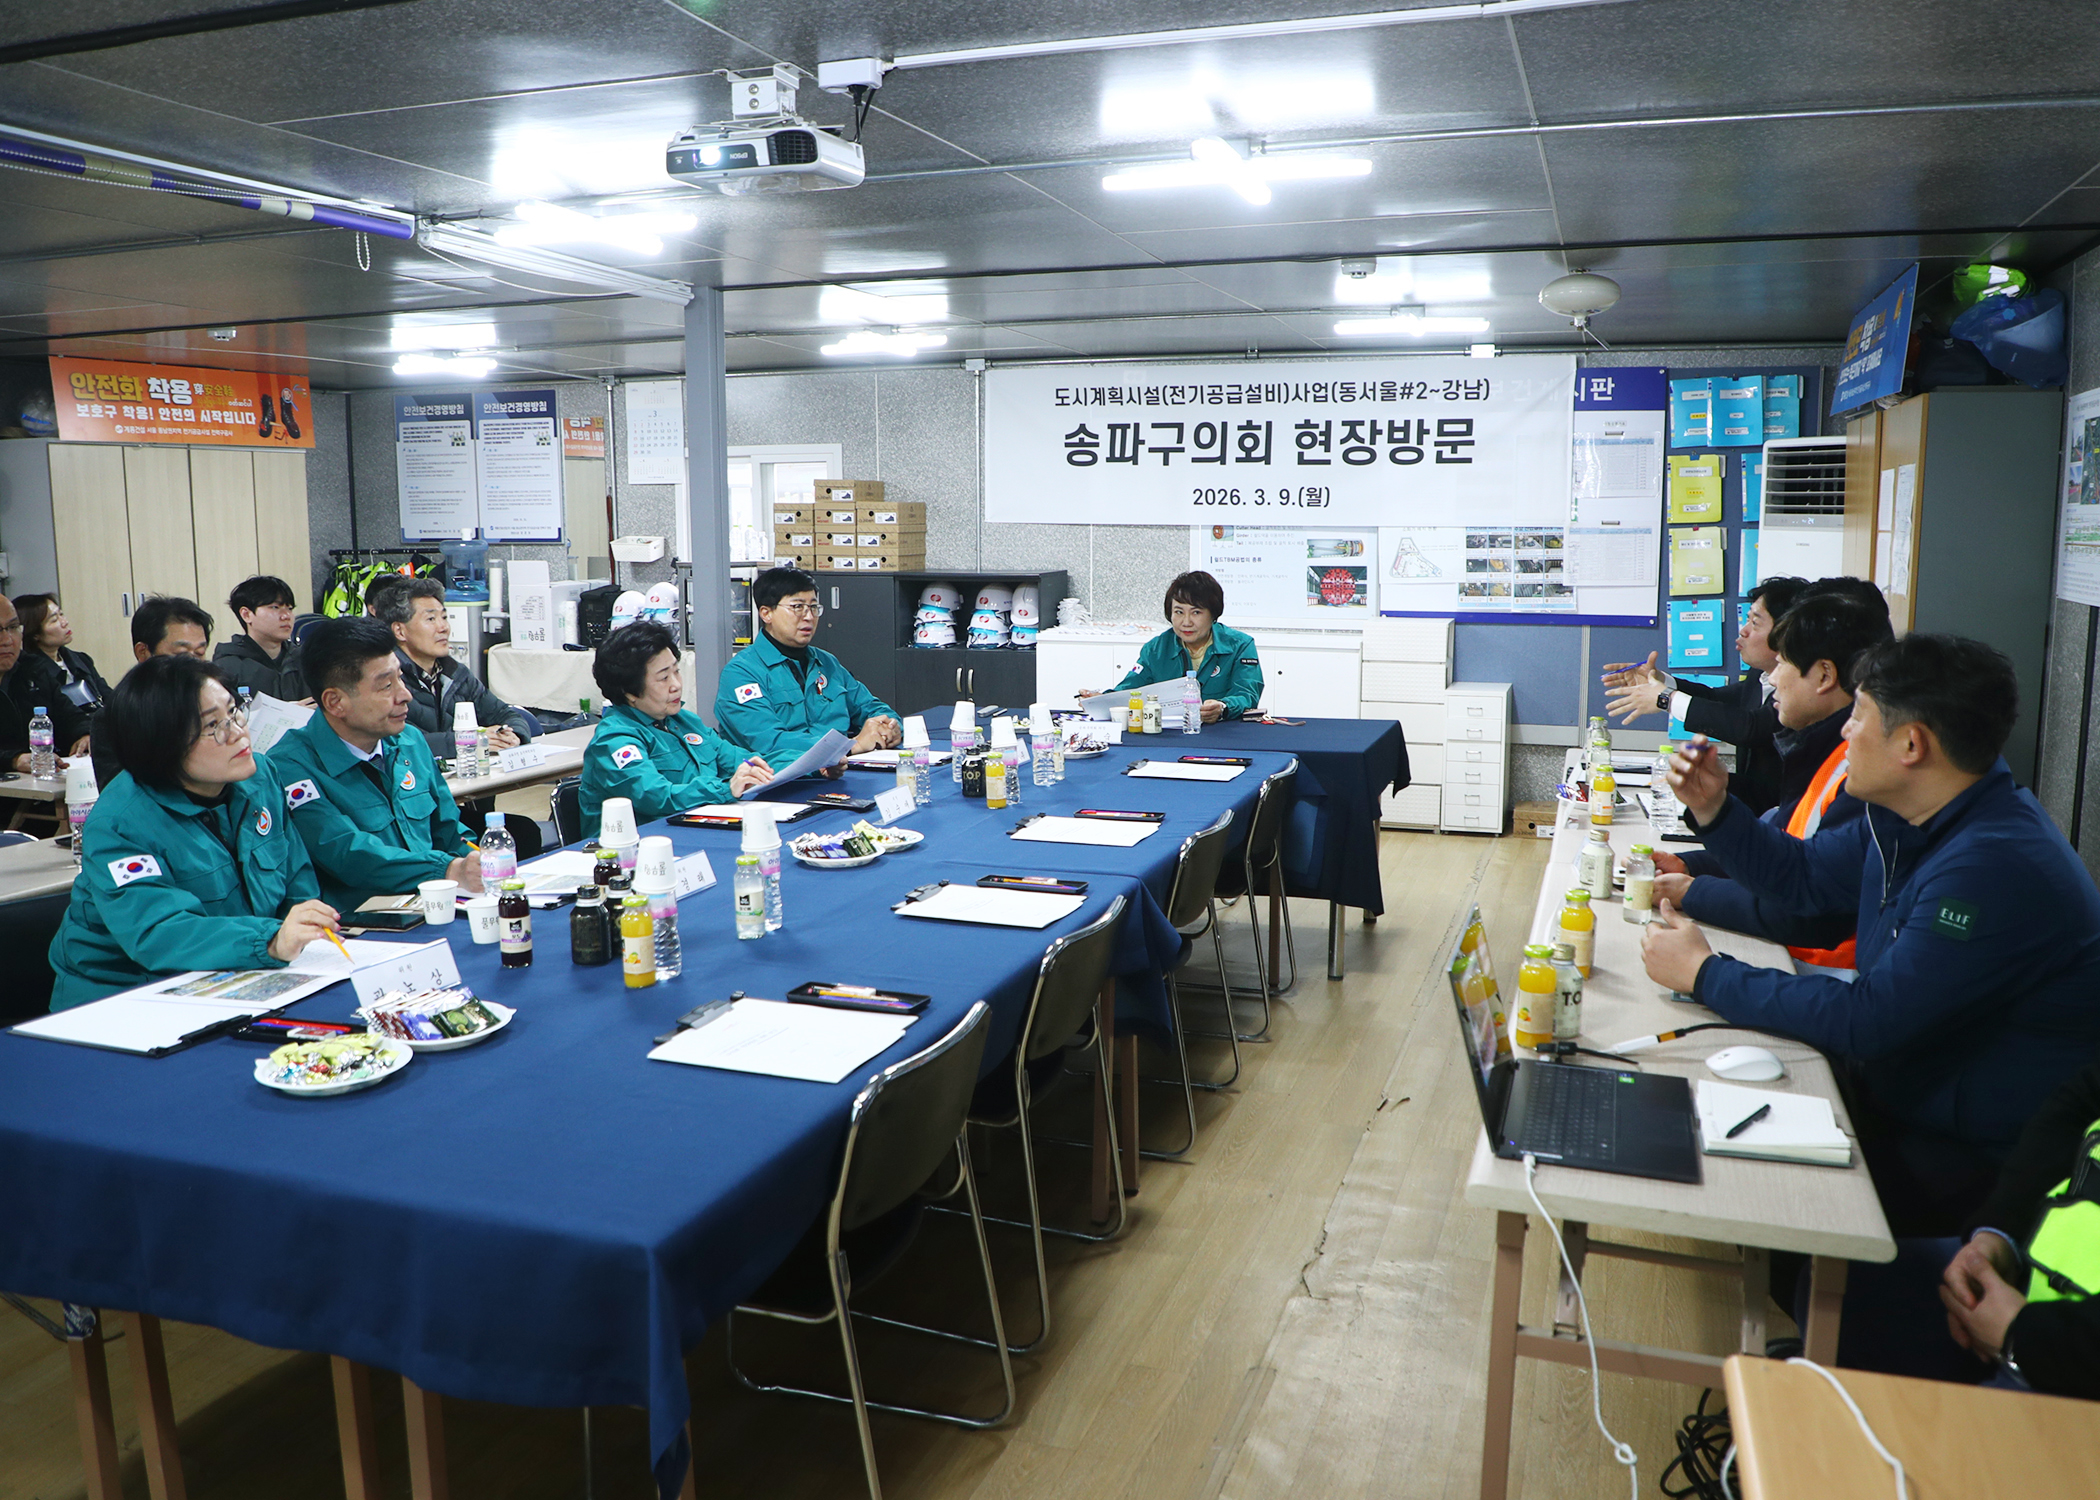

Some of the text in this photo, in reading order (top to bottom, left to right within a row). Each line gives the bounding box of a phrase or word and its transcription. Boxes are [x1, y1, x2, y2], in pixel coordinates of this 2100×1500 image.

[730, 152, 748, 160] EPSON
[70, 372, 192, 404] 안전화 착용
[1054, 378, 1491, 407] 도시계획시설(전기공급설비)사업(동서울#2~강남)
[76, 404, 256, 425] 보호구 착용! 안전의 시작입니다
[404, 404, 464, 416] 안전보건경영방침
[484, 400, 547, 414] 안전보건경영방침
[1064, 418, 1476, 467] 송파구의회 현장방문
[1192, 486, 1331, 508] 2026. 3. 9.(월)
[1940, 908, 1970, 924] ELIF
